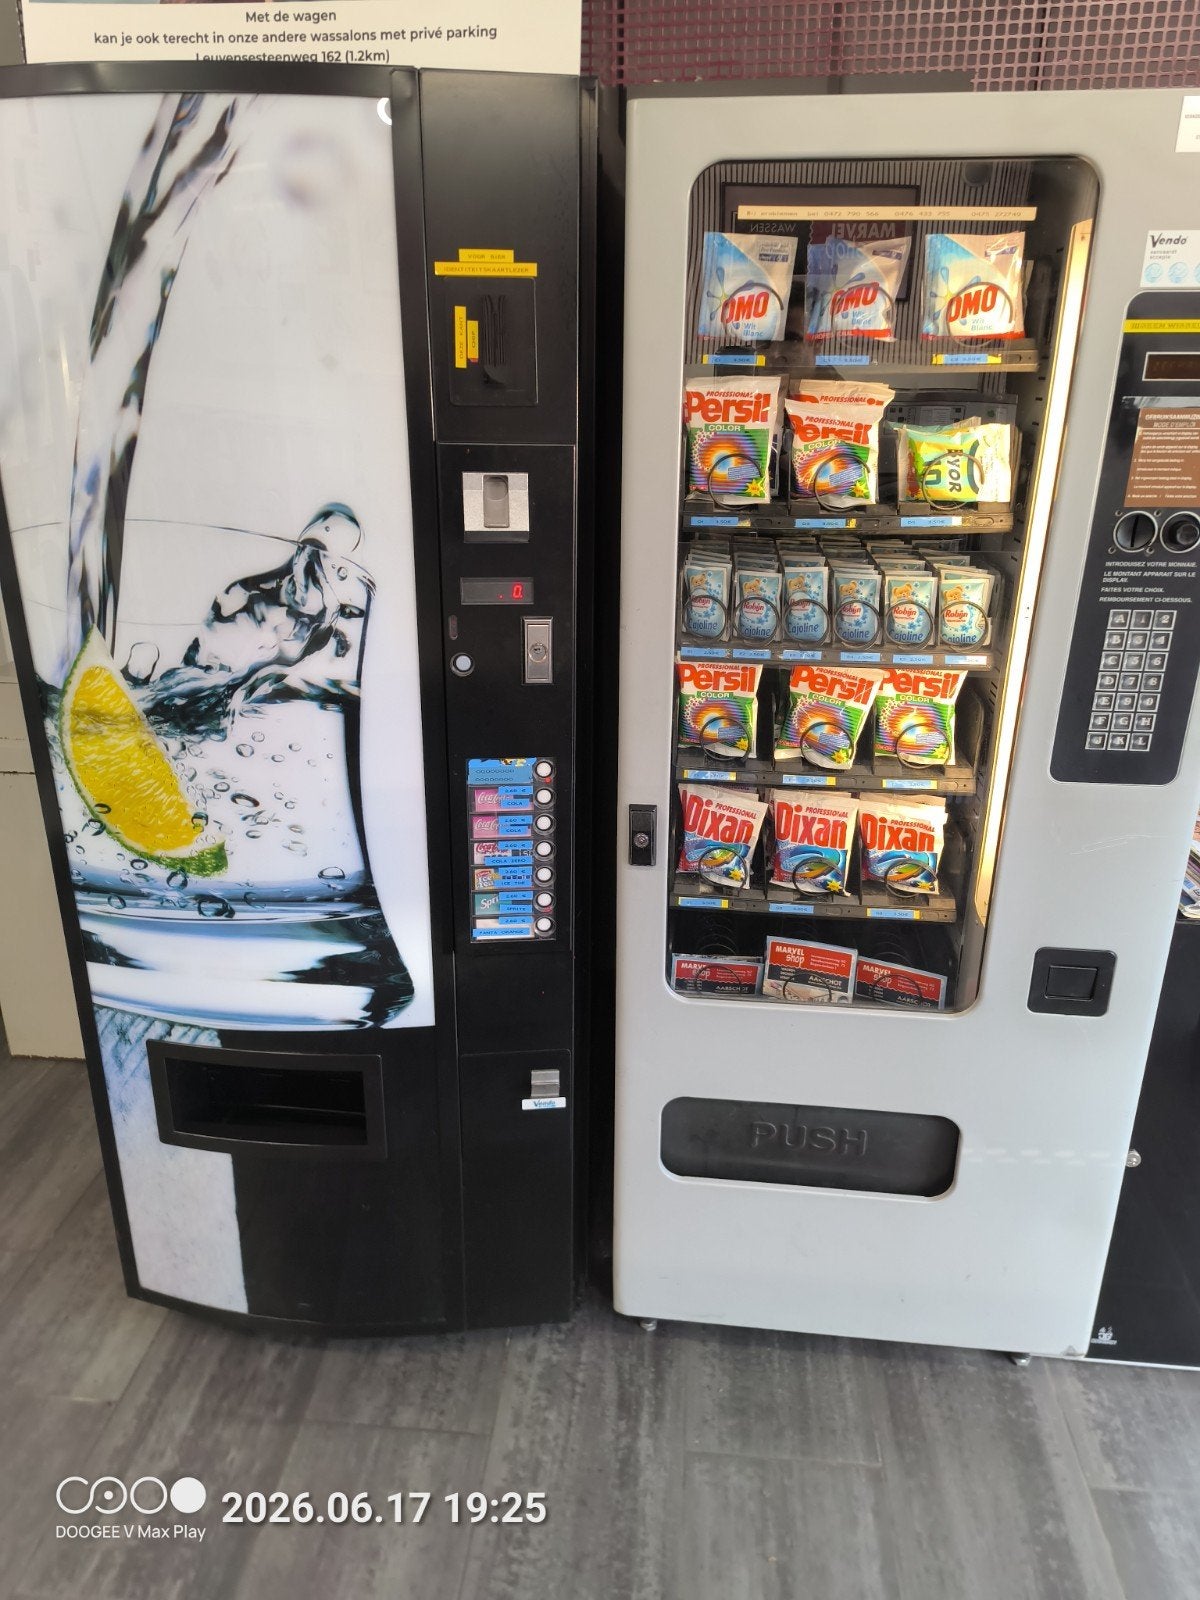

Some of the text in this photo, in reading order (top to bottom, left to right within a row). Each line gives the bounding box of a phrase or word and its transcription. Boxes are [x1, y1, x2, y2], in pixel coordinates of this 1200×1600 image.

[246, 11, 336, 24] Met de wagen
[94, 25, 497, 46] kan je ook terecht in onze andere wassalons met privé parking
[322, 51, 341, 62] 162
[345, 50, 390, 63] (1.2km)
[1150, 233, 1188, 248] Vendo
[830, 282, 879, 316] OMO
[946, 284, 999, 323] OMO
[720, 291, 769, 324] OMO
[706, 391, 754, 399] PROFESSIONAL
[820, 395, 867, 403] PROFESSIONAL
[686, 391, 771, 424] Persil
[708, 424, 741, 432] COLOR
[805, 415, 854, 428] PROFESSIONAL
[893, 604, 917, 617] Robijn
[944, 609, 969, 620] Robijn
[697, 663, 741, 671] PROFESSIONAL
[898, 668, 943, 676] PROFESSIONAL
[678, 663, 757, 692] Persil
[816, 667, 858, 681] PROFESSIONAL
[790, 664, 874, 705] Persil
[879, 668, 960, 699] Persil
[812, 694, 842, 705] COLOR
[900, 695, 930, 703] COLOR
[714, 802, 758, 820] PROFESSIONAL
[805, 806, 849, 818] PROFESSIONAL
[685, 795, 755, 844] Dixan
[776, 801, 848, 849] Dixan
[890, 819, 936, 832] PROFESSIONAL
[861, 813, 935, 852] Dixan
[480, 896, 499, 910] Spri
[775, 945, 805, 956] MARVEL
[896, 995, 931, 1007] AARSCOT
[752, 1120, 868, 1156] PUSH
